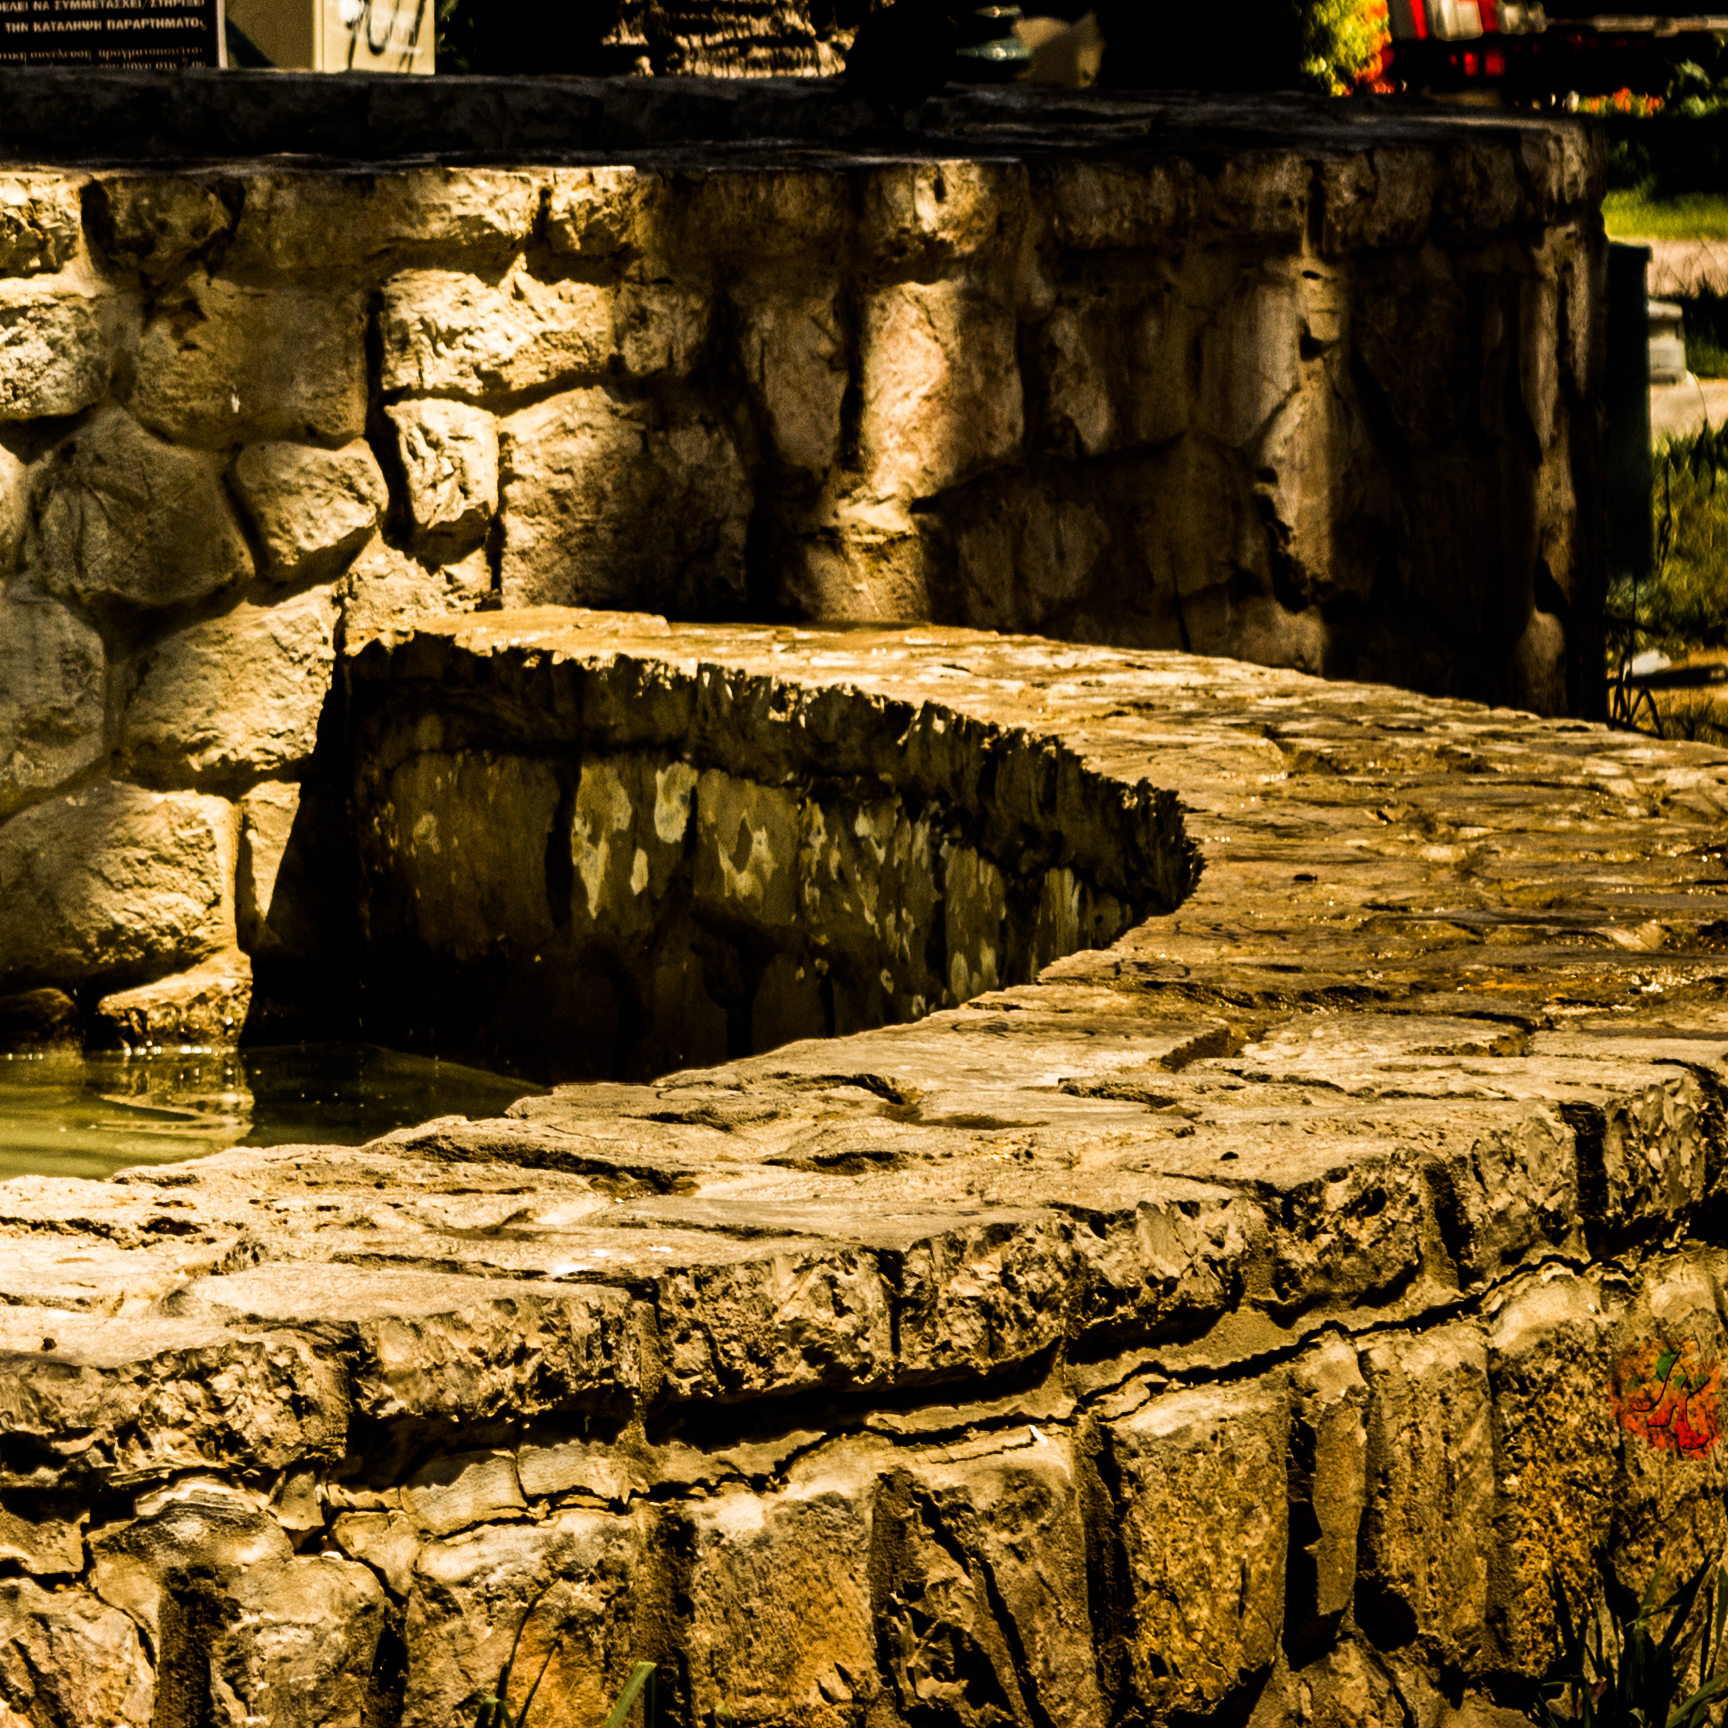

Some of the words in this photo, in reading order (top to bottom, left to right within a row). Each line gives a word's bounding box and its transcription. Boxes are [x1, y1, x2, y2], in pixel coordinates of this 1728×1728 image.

[32, 0, 51, 12] ΝΑ
[4, 21, 29, 34] ΤΗΝ
[32, 18, 103, 33] ΚΑΤΑΛΗΨΗ
